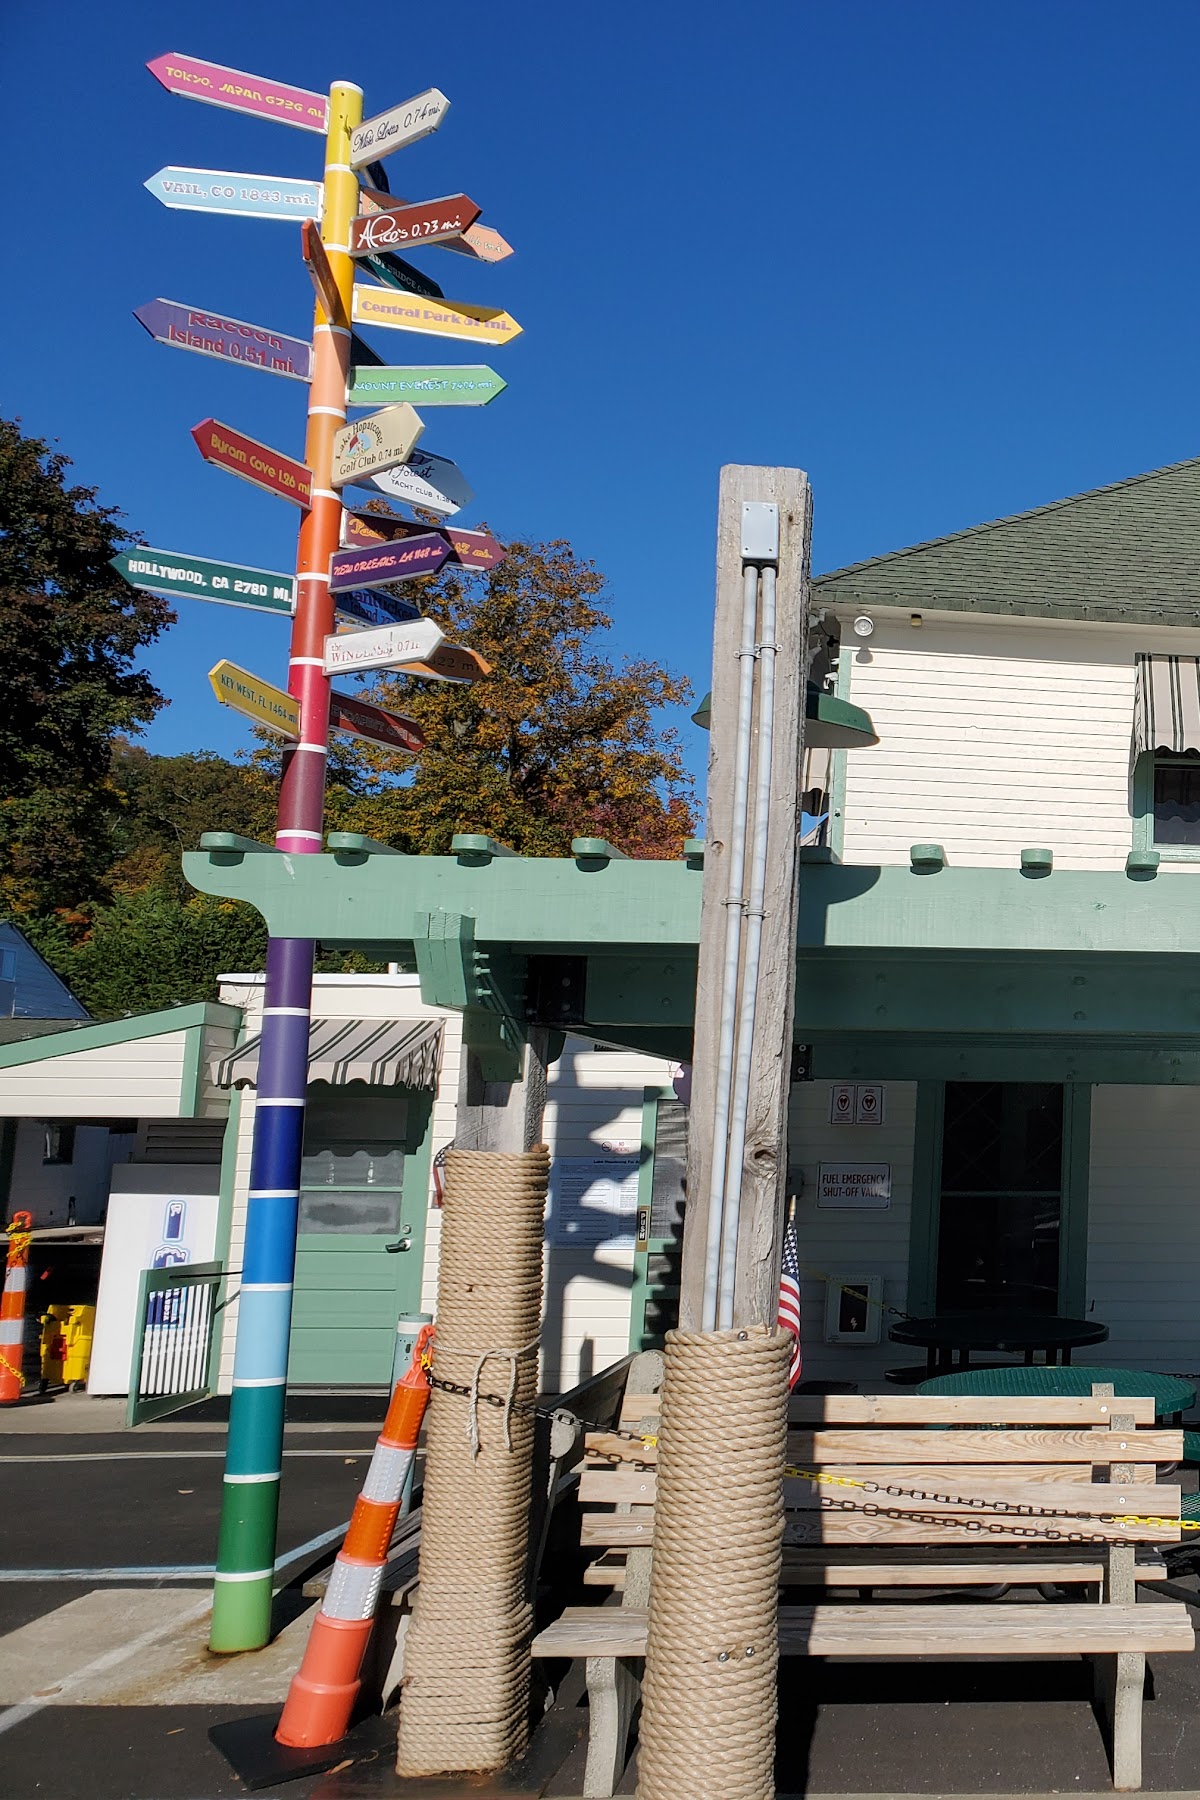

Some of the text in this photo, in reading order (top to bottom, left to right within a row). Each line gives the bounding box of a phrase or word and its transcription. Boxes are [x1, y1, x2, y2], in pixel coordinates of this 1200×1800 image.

[219, 83, 262, 101] JAPAN
[403, 103, 430, 128] 0.74
[162, 181, 315, 205] VAIL, CO 1843 mi.
[357, 215, 409, 248] Alice's
[411, 220, 439, 238] 0.73
[361, 301, 420, 318] Central
[423, 310, 461, 325] Park
[188, 312, 283, 350] Racoon
[168, 324, 297, 374] Island 0.51 mi.
[354, 381, 397, 391] MOUNT
[399, 379, 449, 391] EVEREST
[352, 421, 384, 447] Hopatcong
[210, 432, 247, 463] Byram
[249, 455, 277, 478] Cove
[340, 461, 356, 475] Golf
[357, 453, 377, 469] Club
[378, 448, 392, 462] 0.74
[391, 478, 413, 491] YACHT
[415, 487, 433, 499] CLUB
[333, 565, 353, 576] NEW
[353, 556, 397, 573] ORLEANS,
[398, 552, 414, 563] LA
[128, 559, 207, 587] HOLLYWOOD,
[212, 576, 229, 589] CA
[233, 579, 268, 597] 2780
[221, 673, 235, 690] KEY
[236, 682, 257, 703] WEST,
[258, 695, 267, 709] FL
[269, 701, 287, 719] 1464
[822, 1174, 886, 1184] FUEL EMERGENCY
[823, 1187, 859, 1197] SHUT-OFF
